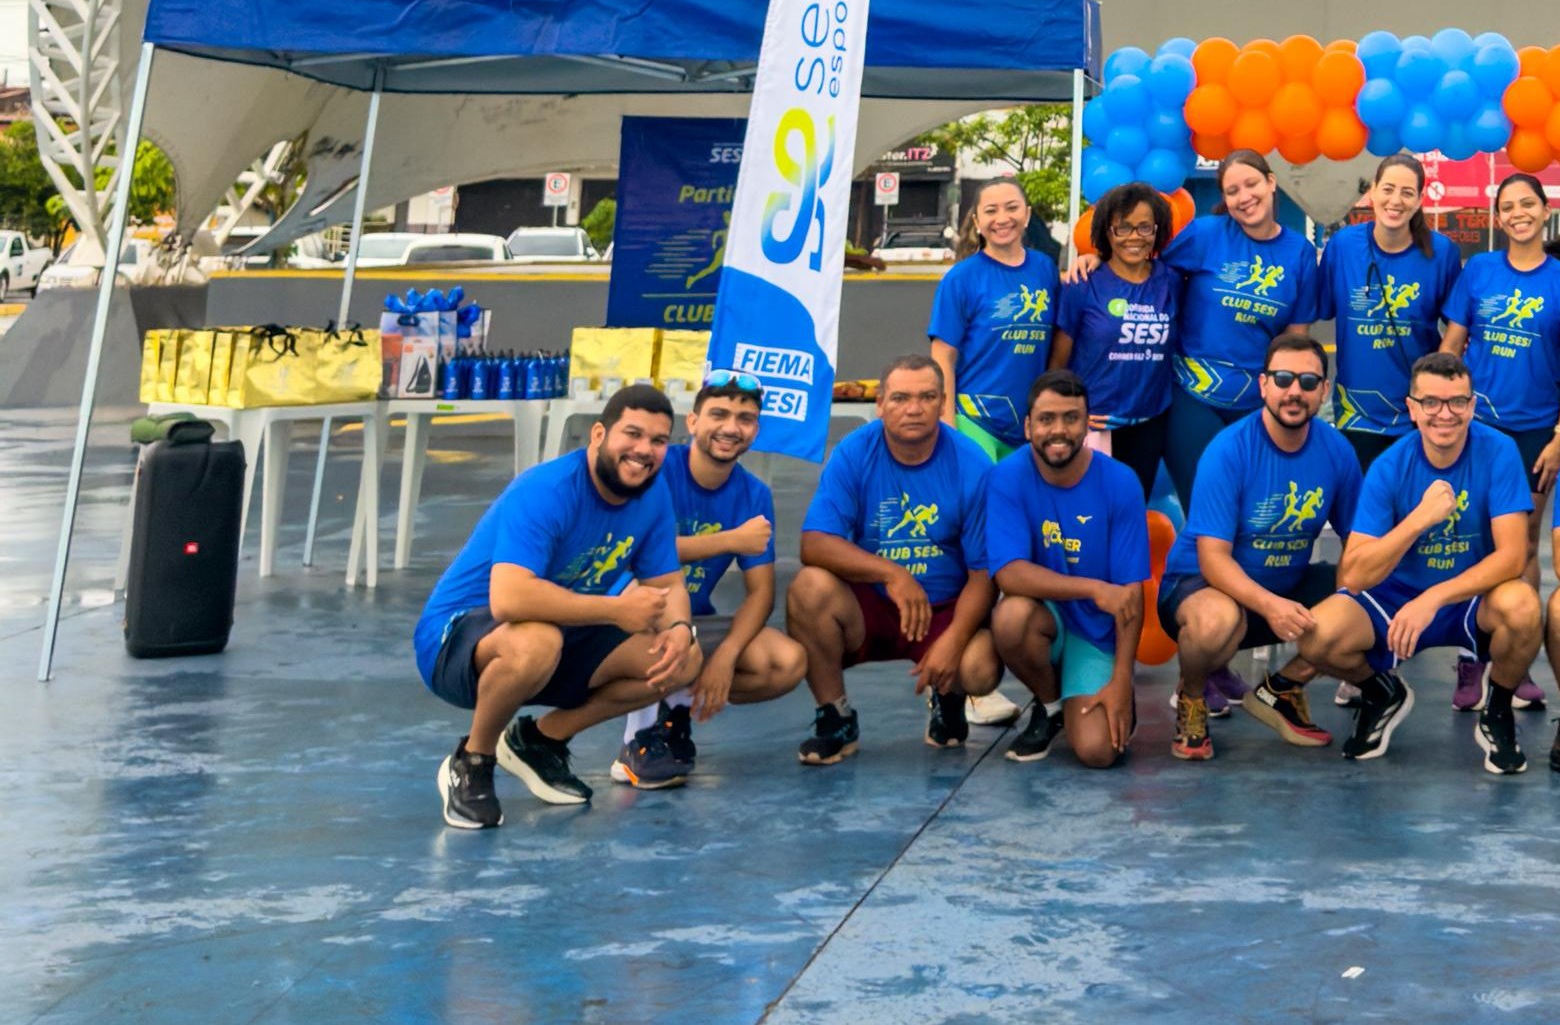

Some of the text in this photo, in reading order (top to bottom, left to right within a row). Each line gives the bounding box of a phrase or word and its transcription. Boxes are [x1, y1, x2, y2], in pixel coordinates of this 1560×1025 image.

[709, 147, 743, 164] SES
[678, 185, 736, 204] Parti
[664, 304, 715, 323] CLUB
[1221, 296, 1279, 317] CLUB SESI
[1508, 334, 1532, 347] SESI
[1491, 345, 1516, 358] RUN
[740, 348, 811, 377] FIEMA
[762, 390, 803, 415] ESI
[1444, 541, 1469, 555] SESI
[1264, 554, 1292, 567] RUN
[1427, 557, 1455, 570] RUN
[905, 562, 928, 575] UN
